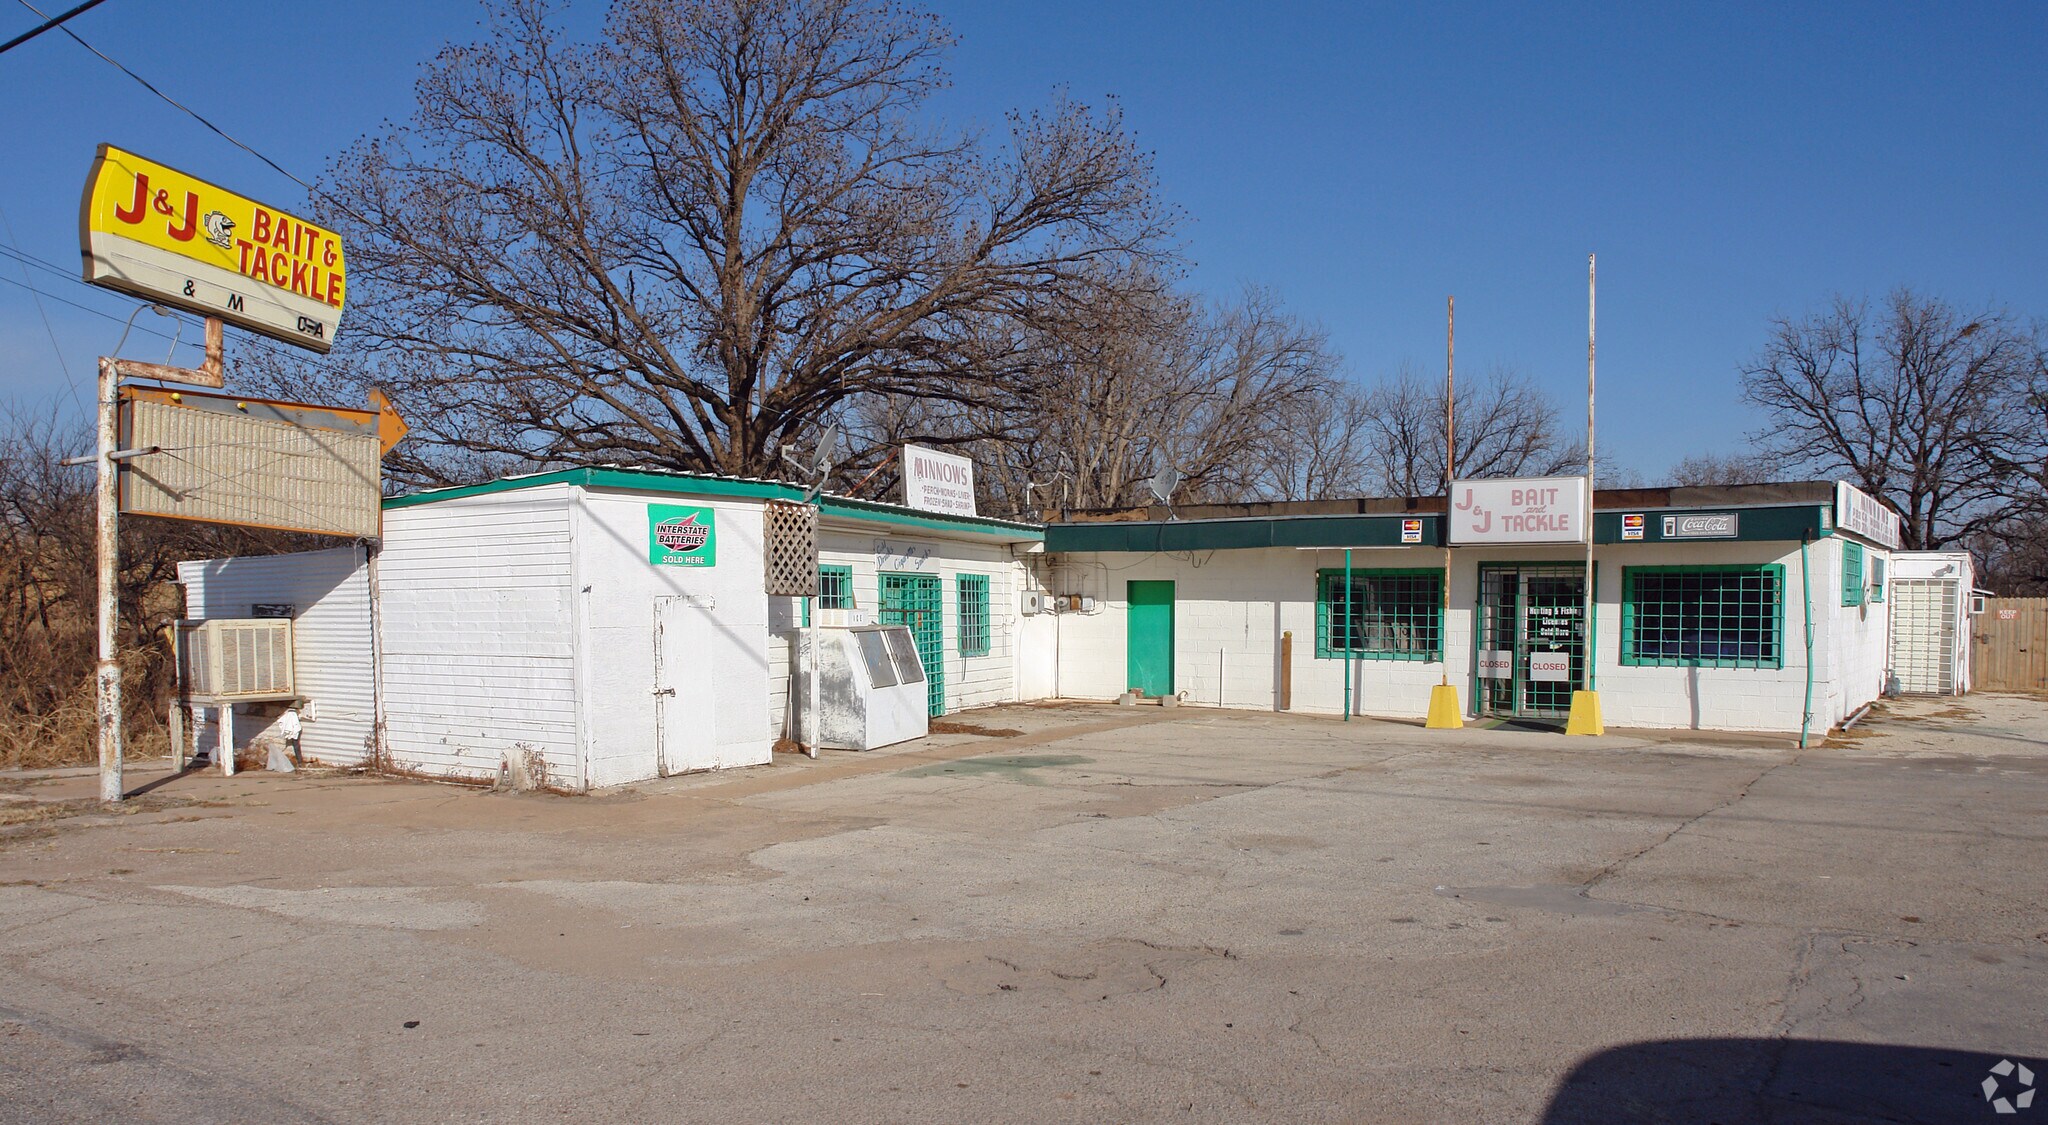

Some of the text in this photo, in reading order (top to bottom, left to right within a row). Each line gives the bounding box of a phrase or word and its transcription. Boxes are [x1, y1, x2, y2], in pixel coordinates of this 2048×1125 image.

[251, 207, 338, 267] BAIT &
[235, 238, 342, 307] TACKLE
[183, 279, 196, 298] &
[227, 293, 245, 313] M
[914, 457, 968, 486] MINNOWS
[1511, 488, 1559, 507] BAIT
[1523, 504, 1547, 514] and
[657, 525, 708, 535] INTERSTATE
[1501, 514, 1569, 532] TACKLE
[1681, 516, 1730, 532] Coca-Cola
[659, 535, 705, 545] BATTERIES
[662, 555, 705, 564] SOLD HERE
[1479, 660, 1510, 668] CLOSED
[1532, 662, 1567, 671] CLOSED
